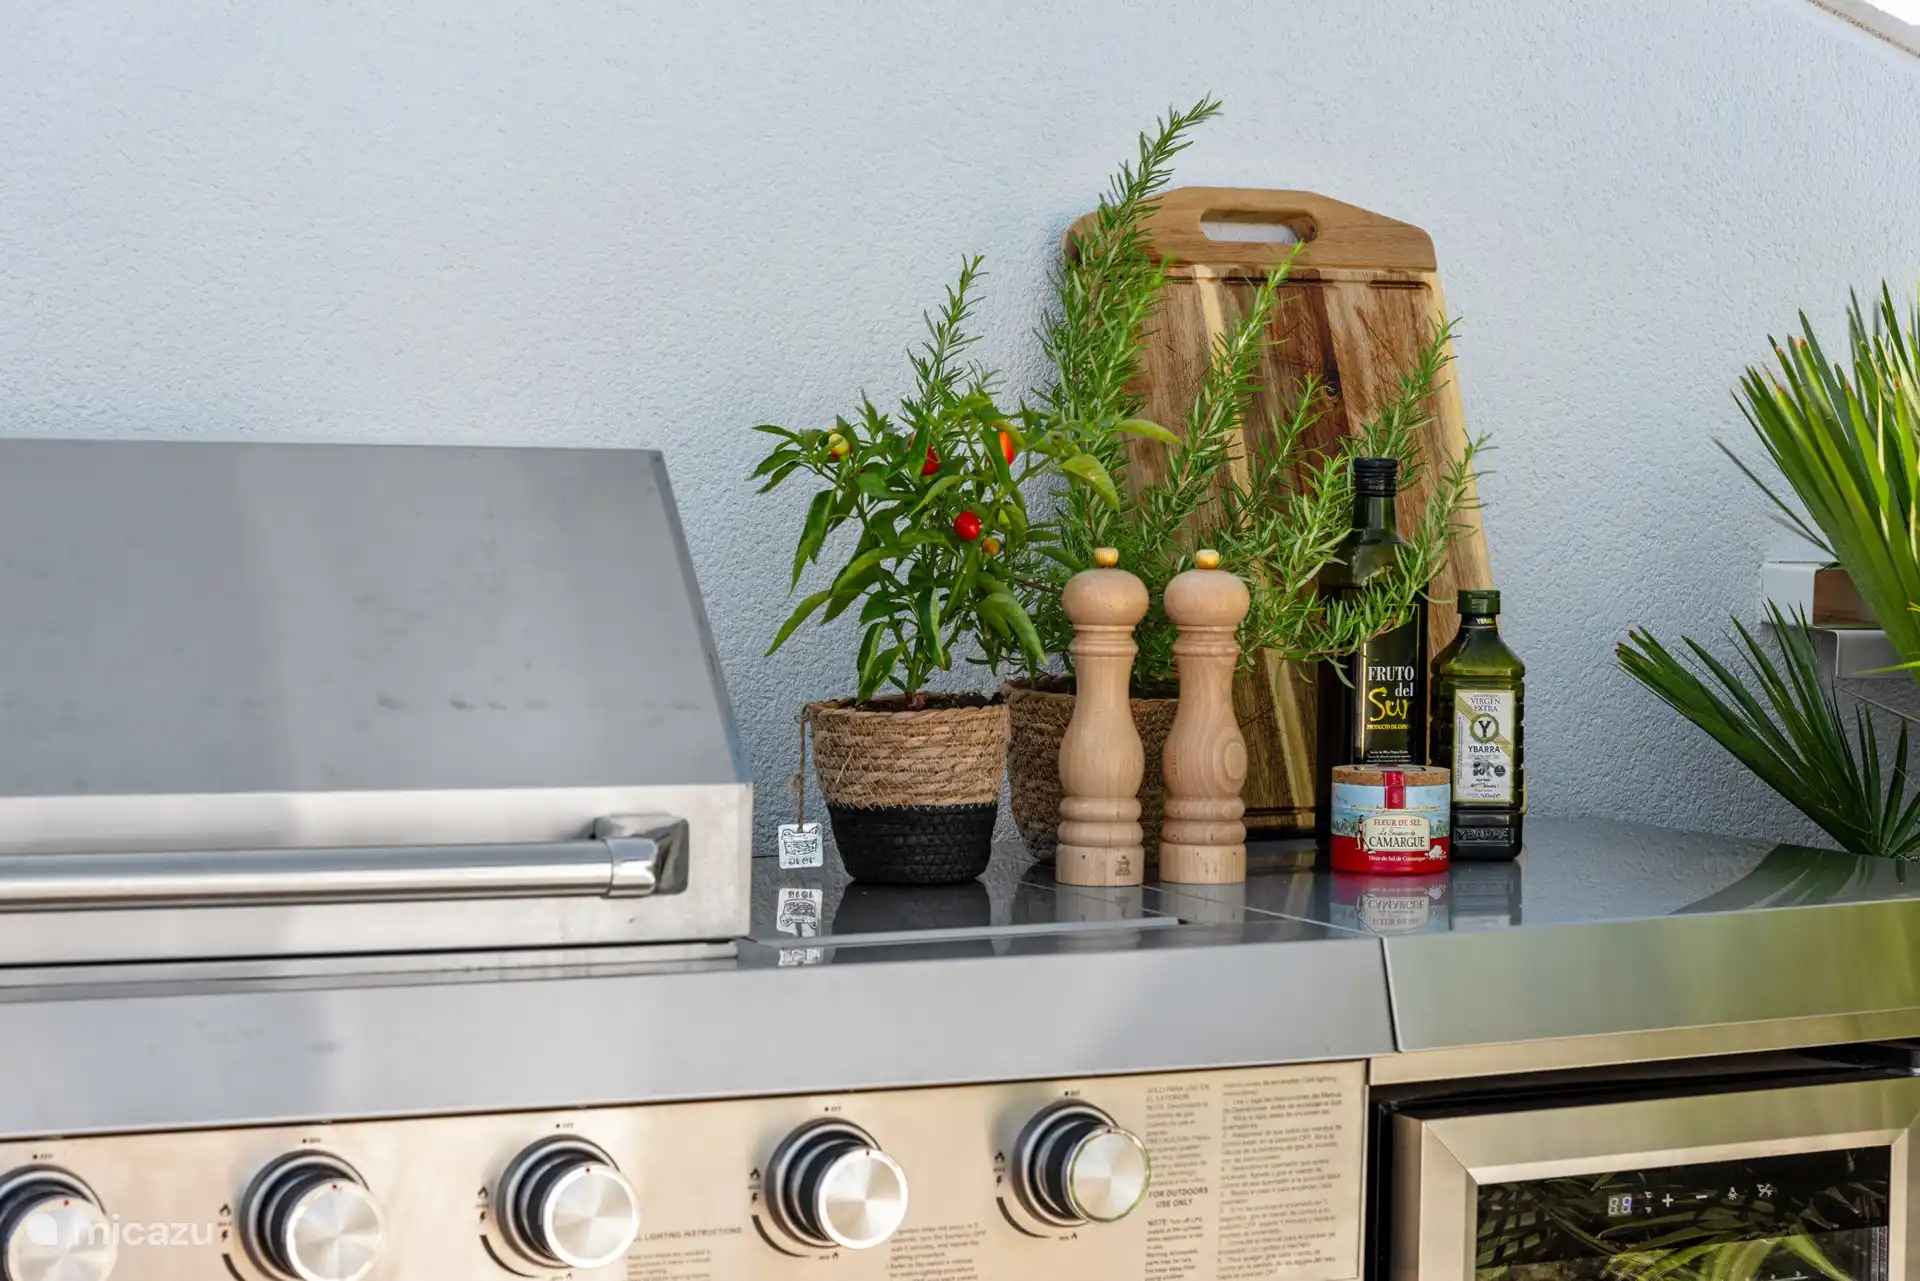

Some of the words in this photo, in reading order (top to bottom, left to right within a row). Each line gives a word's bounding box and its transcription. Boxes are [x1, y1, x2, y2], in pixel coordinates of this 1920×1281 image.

[1368, 666, 1415, 681] FRUTO
[1395, 682, 1414, 697] del
[1368, 686, 1413, 722] Sur
[1471, 698, 1501, 706] VIRGEN
[1474, 705, 1498, 713] EXTRA
[1478, 720, 1492, 738] Y
[1468, 745, 1501, 754] YBARRA
[1374, 819, 1396, 827] FLEUR
[1398, 819, 1408, 827] DE
[1410, 818, 1422, 827] SEL
[1369, 836, 1425, 848] CAMARGUE
[1149, 1191, 1164, 1199] FOR
[1166, 1187, 1209, 1198] OUTDOORS
[1156, 1200, 1170, 1208] USE
[1173, 1199, 1192, 1207] ONLY
[645, 1230, 682, 1241] LIGHTING
[684, 1226, 742, 1238] INSTRUCTIONS
